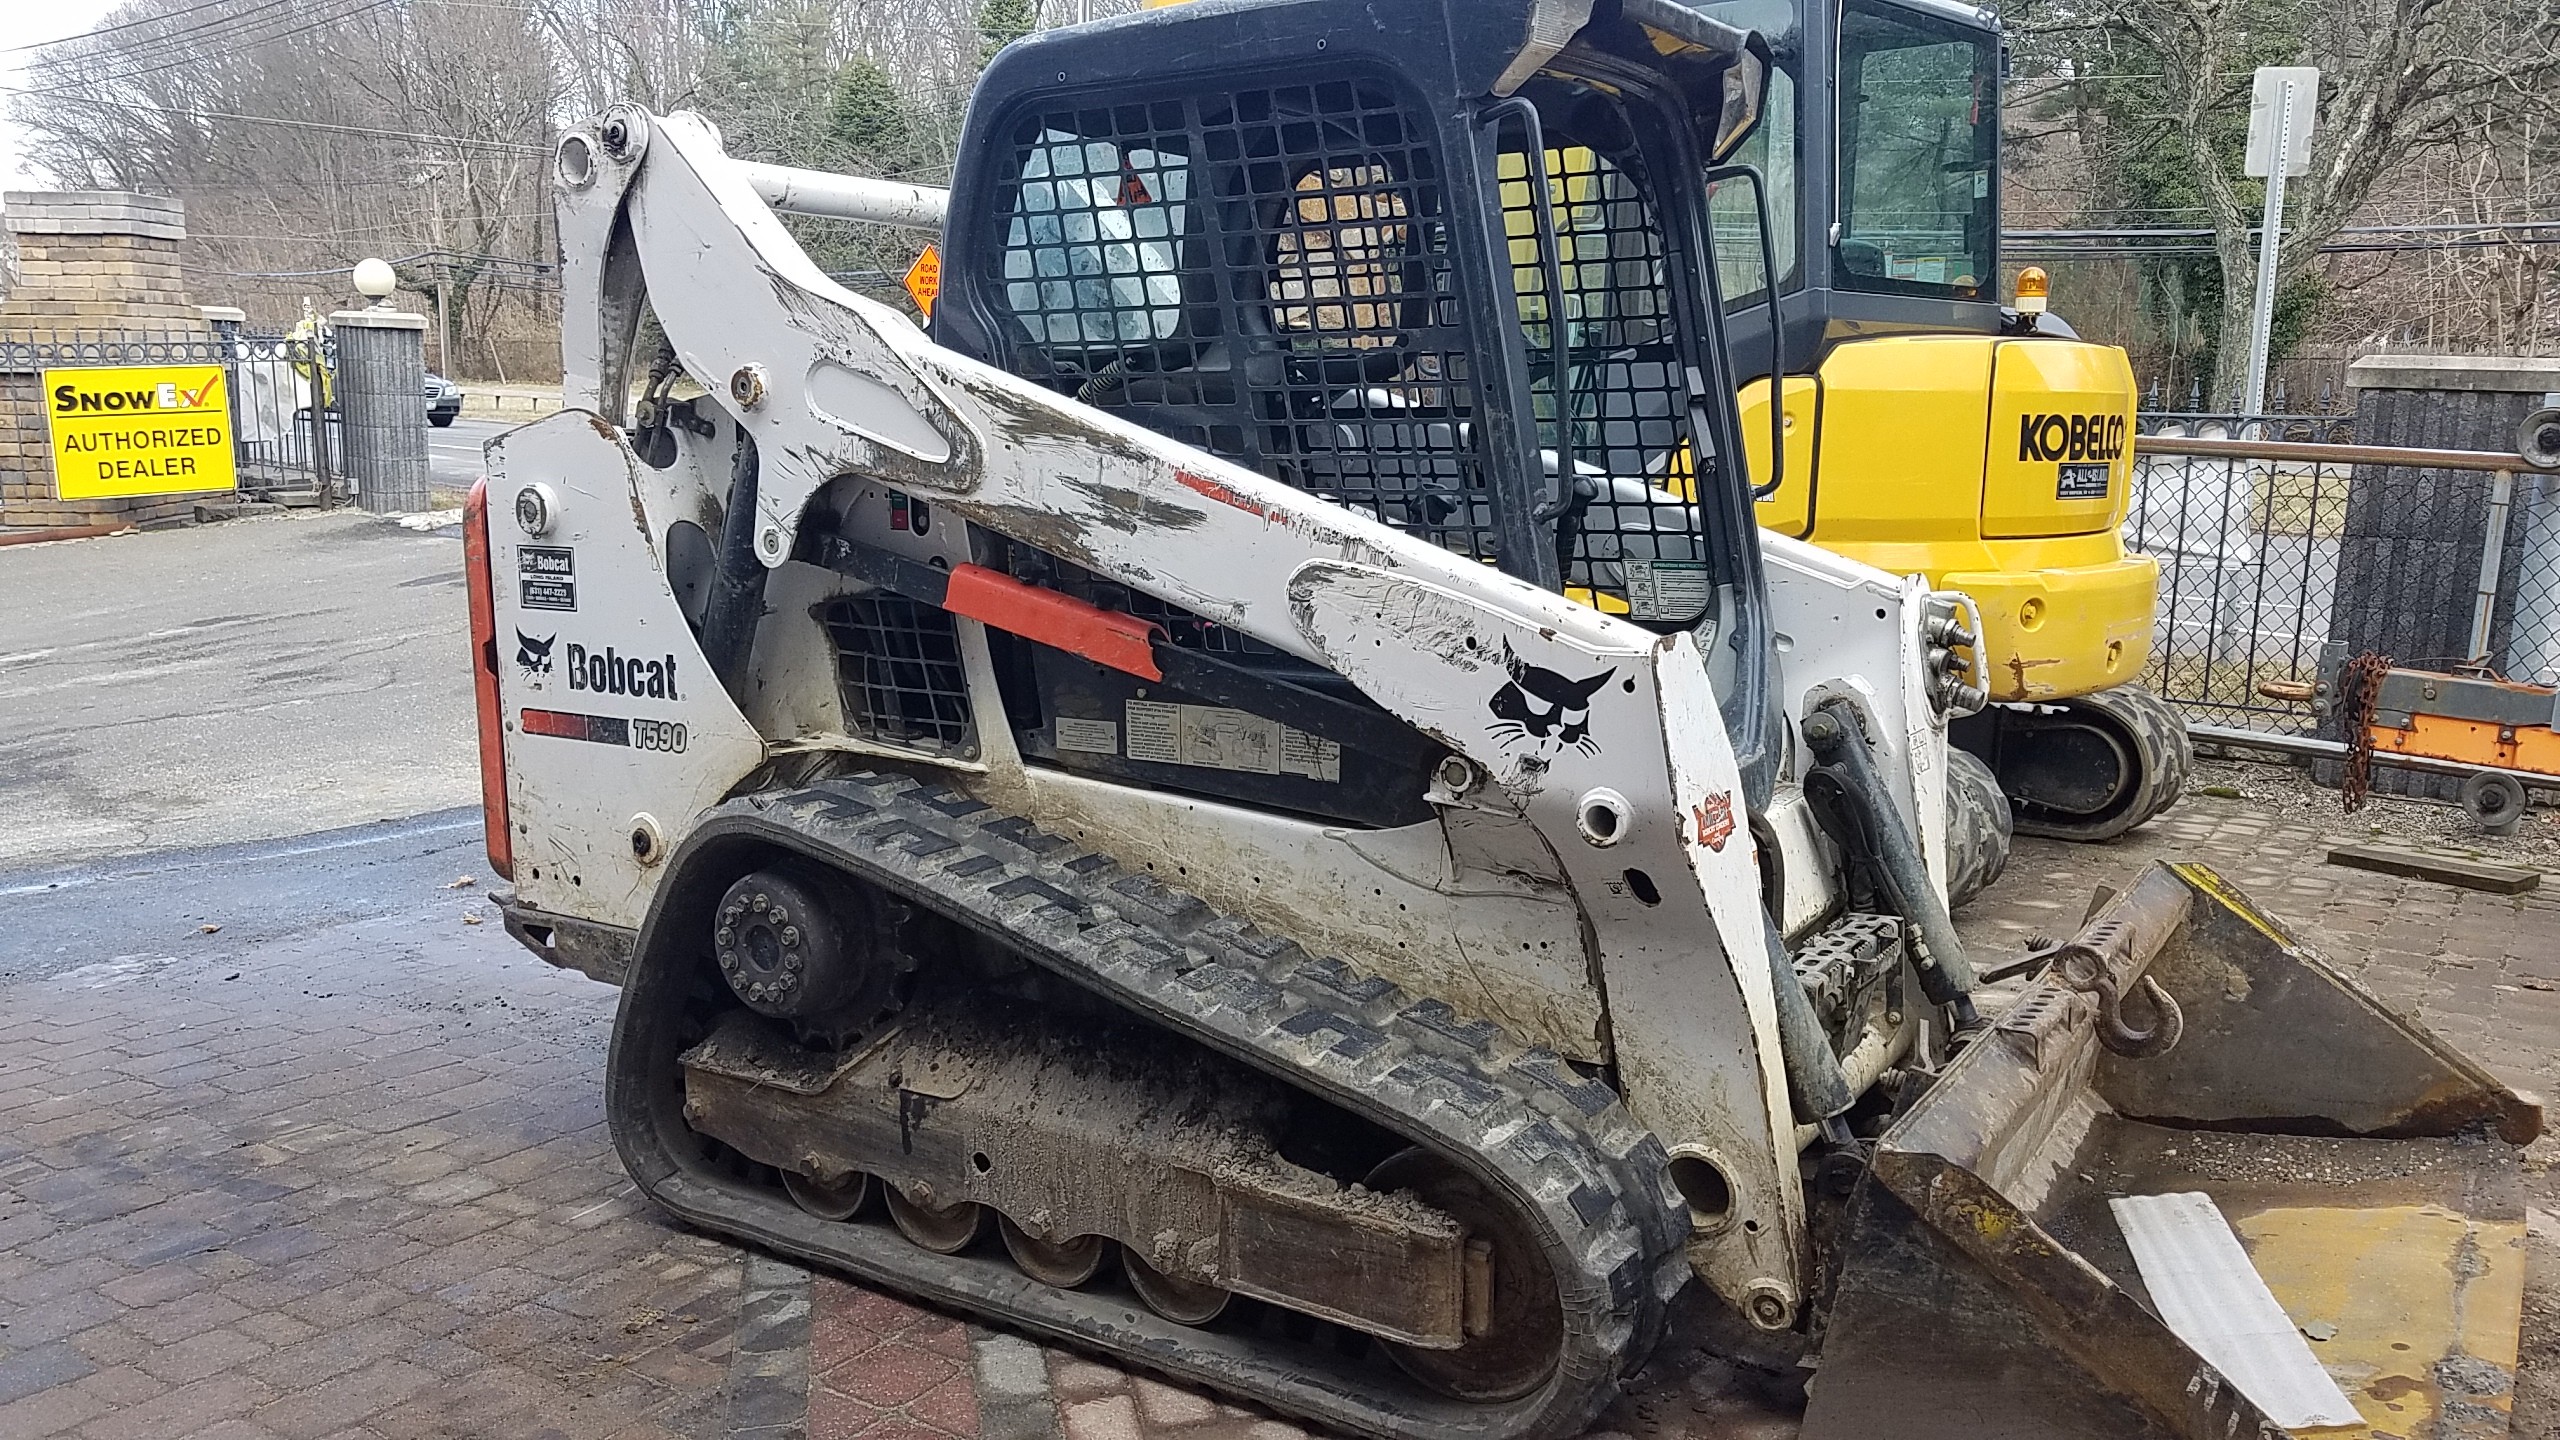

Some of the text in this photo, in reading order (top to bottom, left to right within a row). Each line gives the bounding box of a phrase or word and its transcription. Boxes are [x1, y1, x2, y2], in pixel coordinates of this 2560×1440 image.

[920, 276, 938, 285] WORK
[921, 264, 938, 273] ROAD
[64, 428, 221, 453] AUTHORIZED
[2019, 414, 2125, 462] KOBELCO
[98, 457, 196, 480] DEALER
[536, 554, 570, 572] Bobcat
[567, 642, 678, 702] Bobcat
[633, 718, 688, 754] T590
